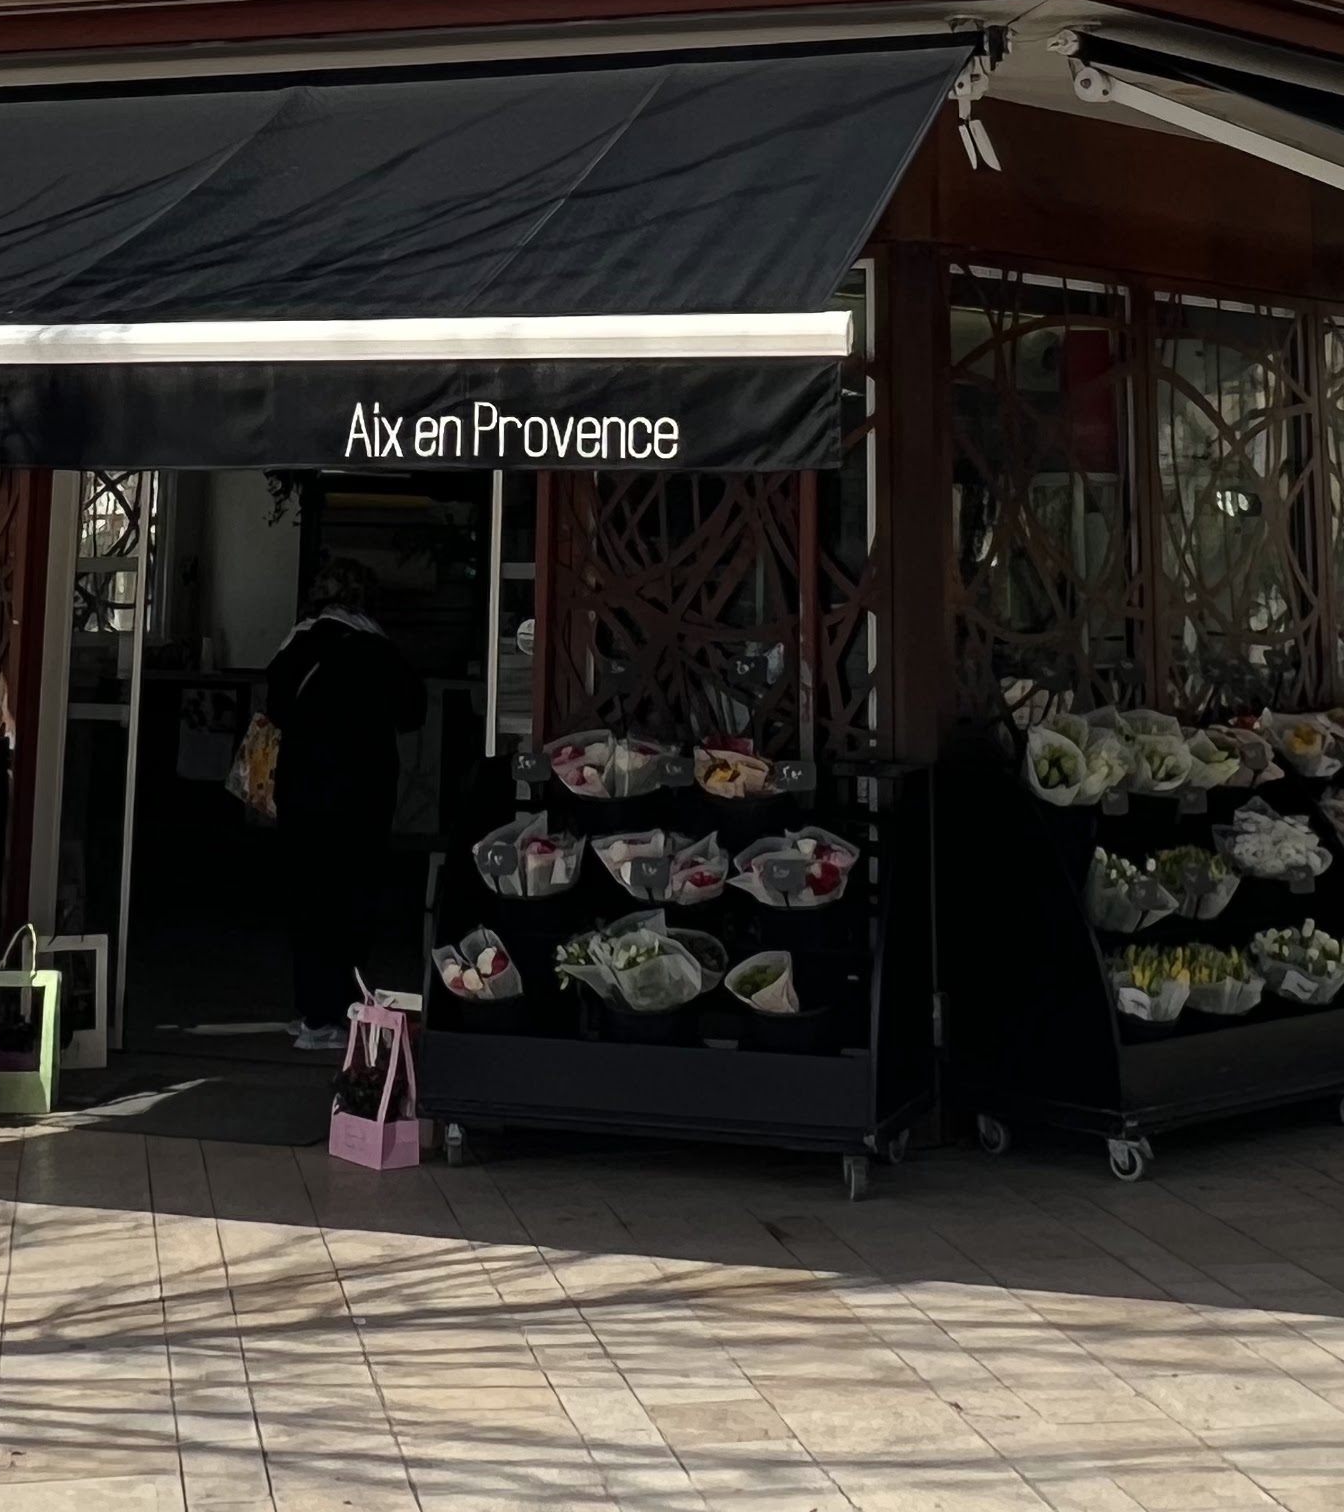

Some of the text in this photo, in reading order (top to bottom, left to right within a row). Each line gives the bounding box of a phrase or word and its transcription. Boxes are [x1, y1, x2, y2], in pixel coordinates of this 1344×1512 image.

[344, 401, 679, 459] Aix en Provence
